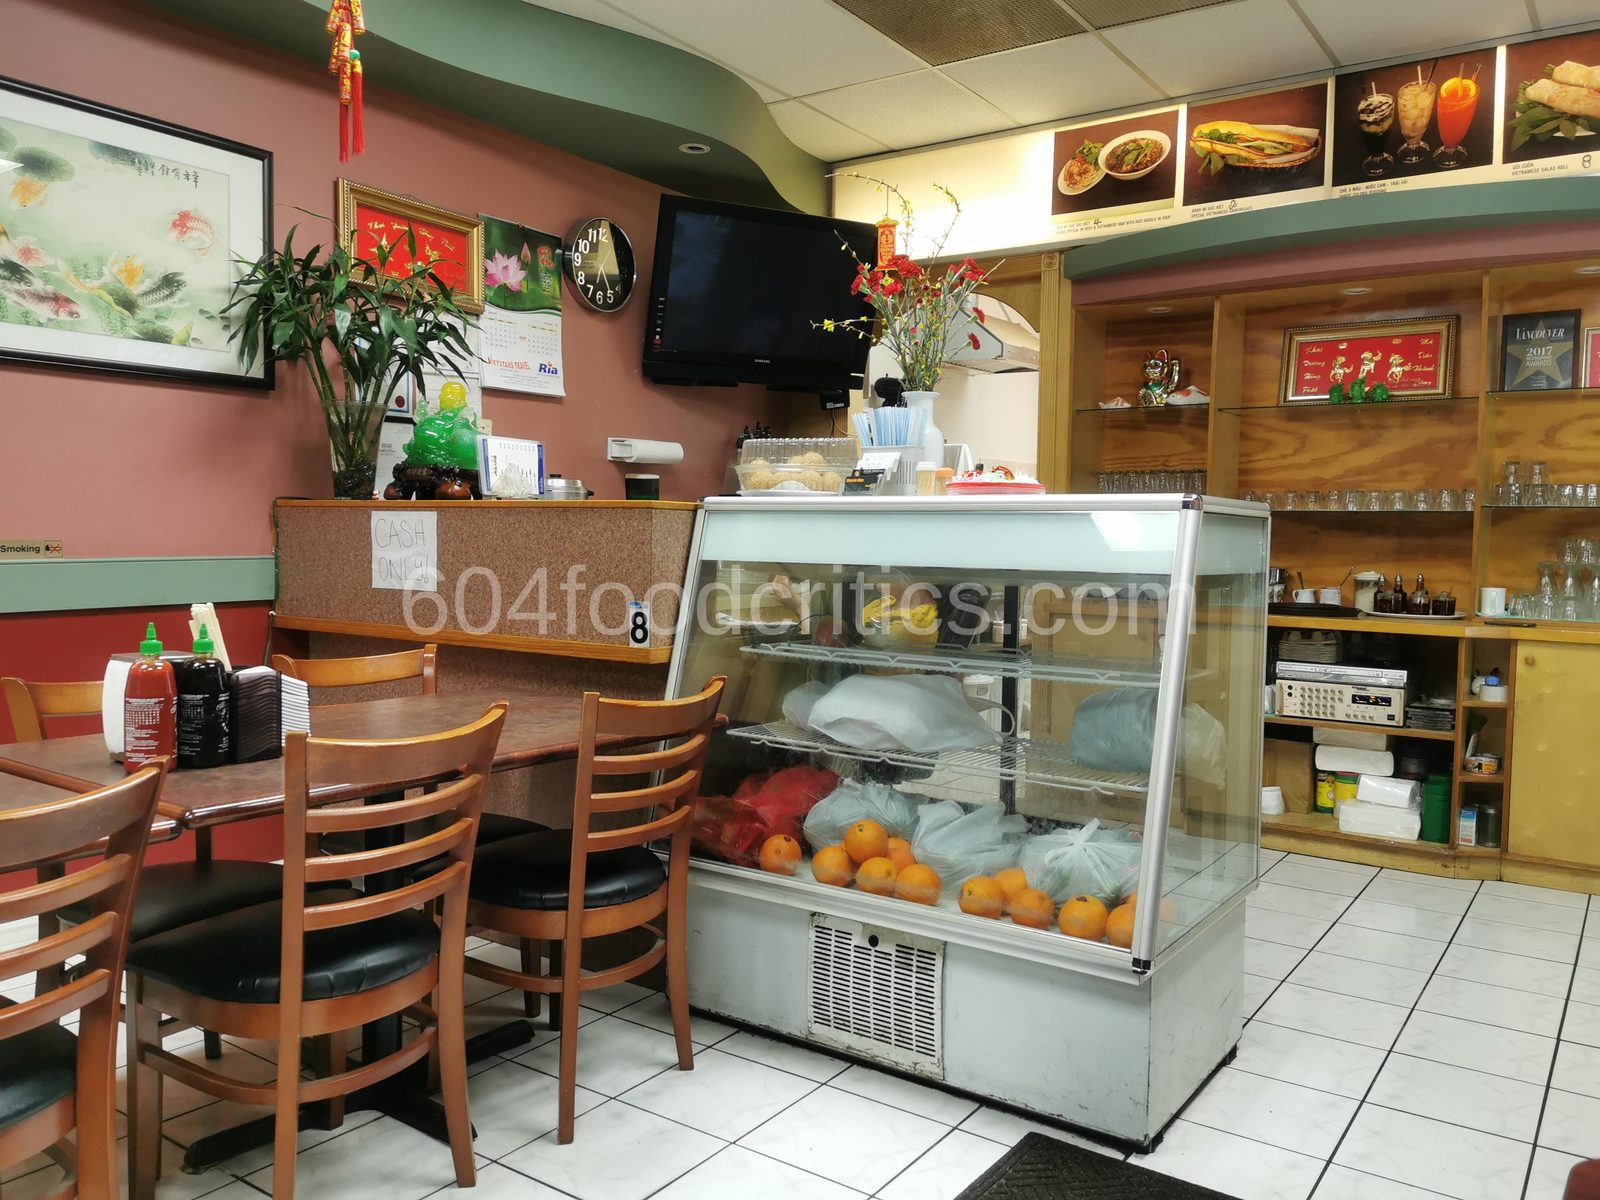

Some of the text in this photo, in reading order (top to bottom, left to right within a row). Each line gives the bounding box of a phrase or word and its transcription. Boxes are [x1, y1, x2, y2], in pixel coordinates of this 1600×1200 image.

[1582, 154, 1592, 168] 8
[588, 228, 596, 243] 11
[598, 227, 608, 242] 12
[578, 239, 590, 254] 10
[574, 253, 581, 266] 9
[578, 271, 585, 285] 8
[587, 285, 593, 298] 7
[596, 291, 603, 304] 6
[607, 290, 614, 303] 5
[1526, 346, 1552, 356] 2017
[539, 361, 558, 375] Ria
[375, 518, 425, 548] CASH
[0, 544, 40, 554] Smoking
[631, 612, 648, 644] 8
